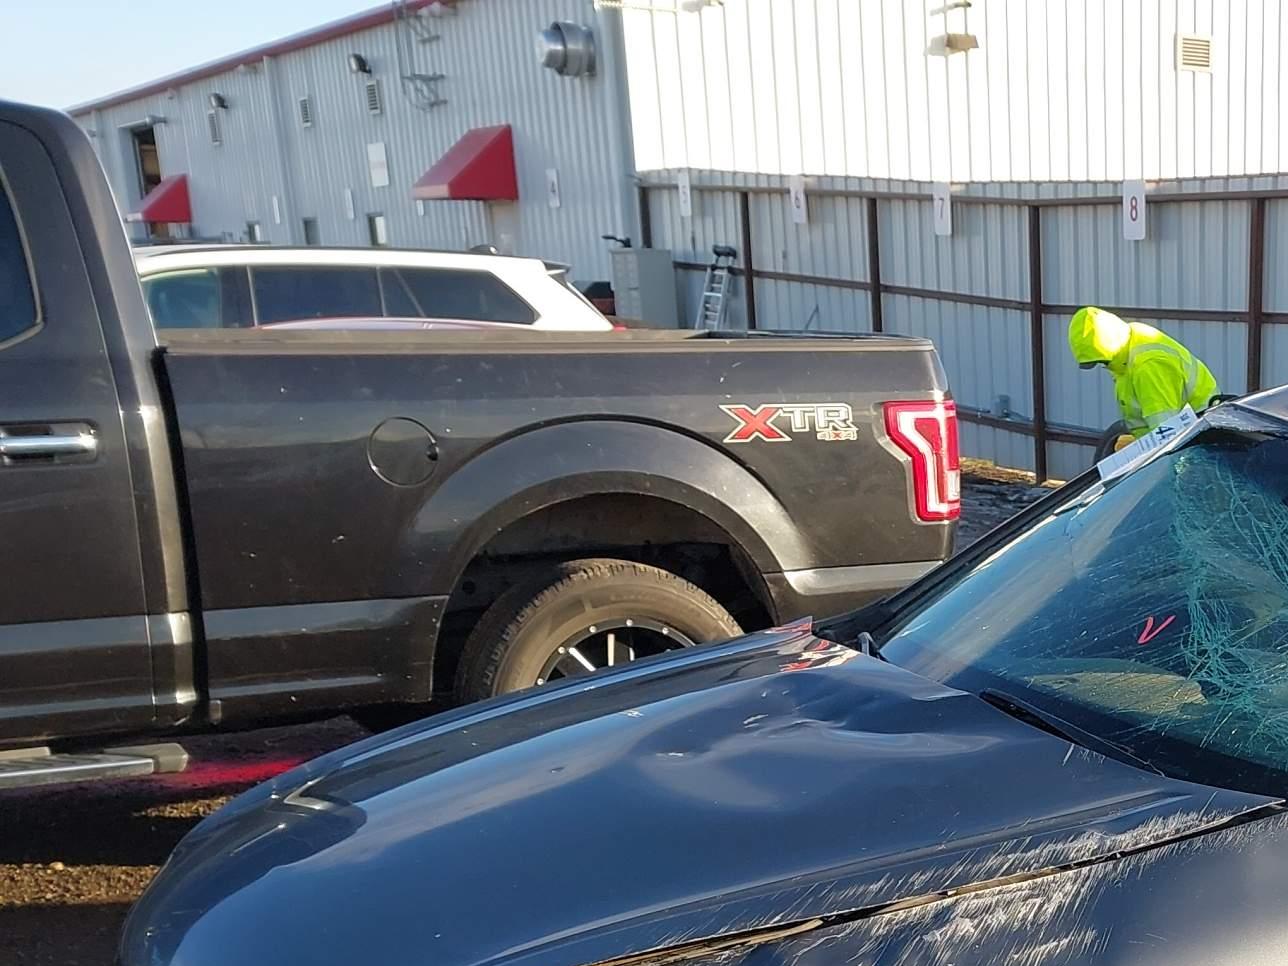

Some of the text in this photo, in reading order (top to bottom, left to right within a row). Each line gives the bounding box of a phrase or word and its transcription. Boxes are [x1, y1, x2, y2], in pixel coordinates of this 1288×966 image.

[938, 197, 945, 219] 7
[1130, 195, 1138, 222] 8
[718, 403, 860, 443] XTR
